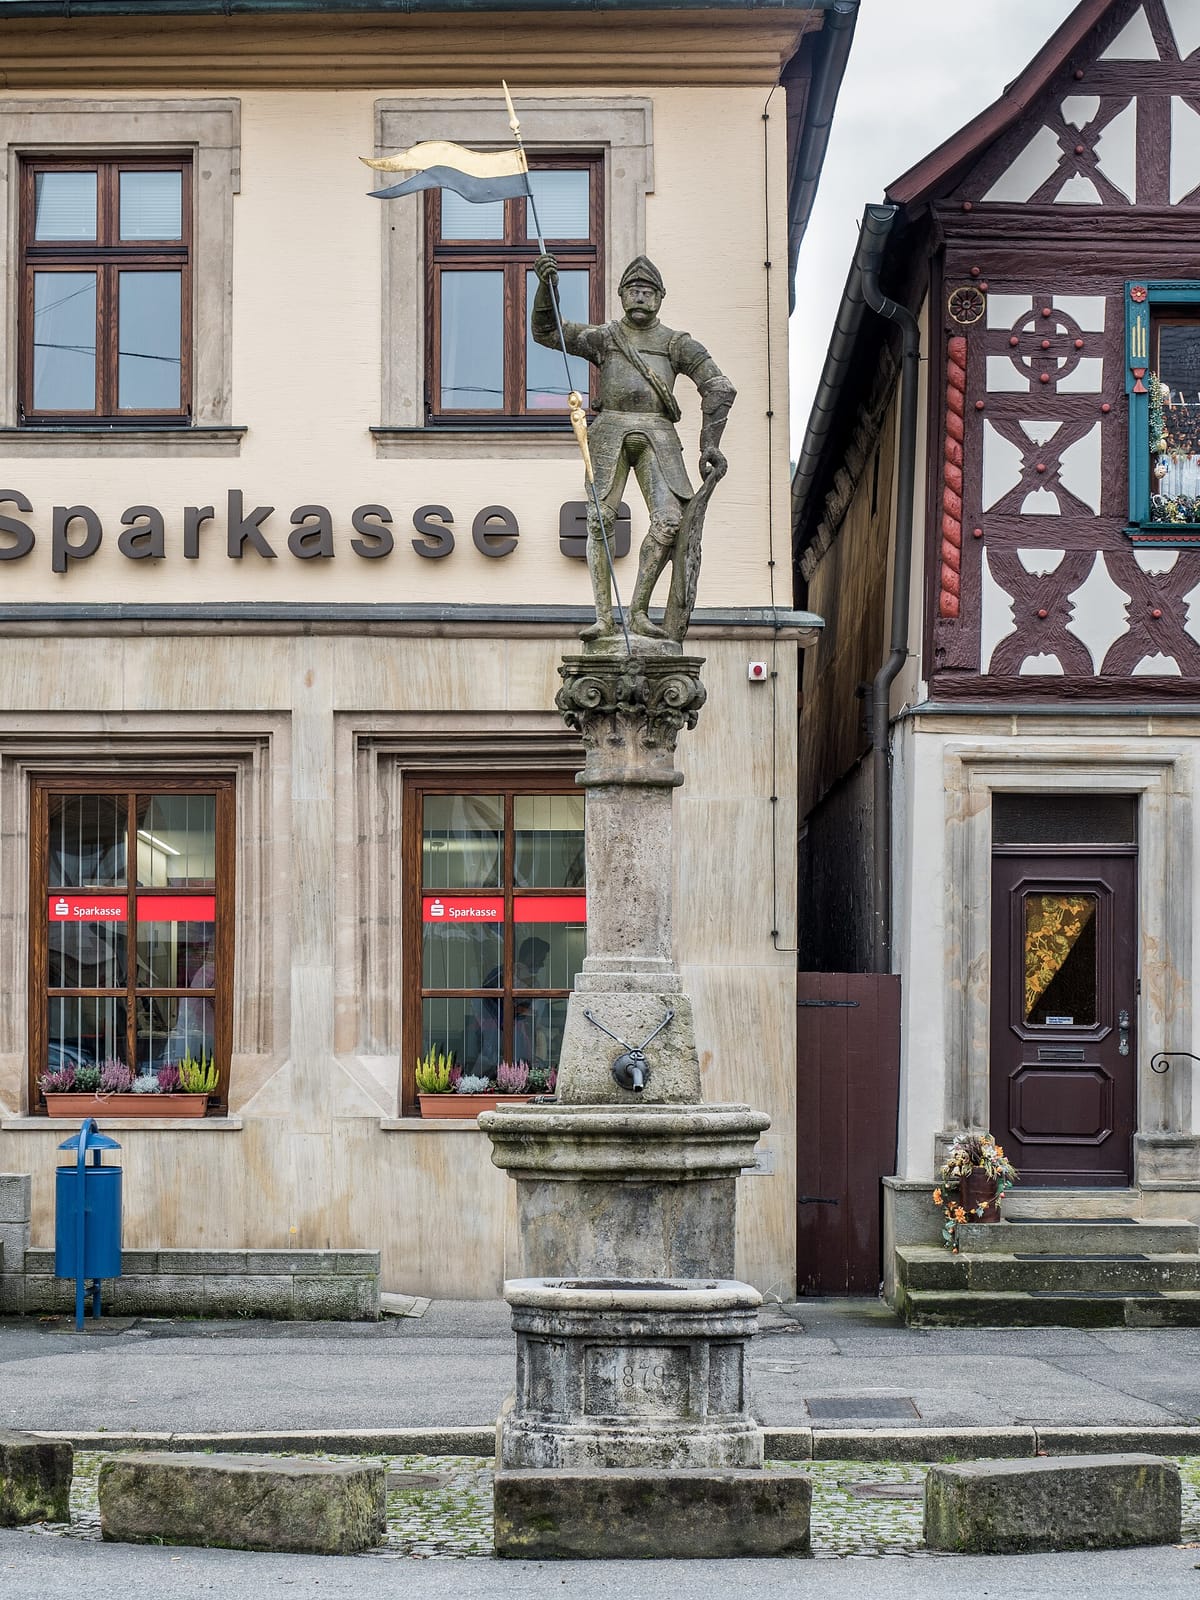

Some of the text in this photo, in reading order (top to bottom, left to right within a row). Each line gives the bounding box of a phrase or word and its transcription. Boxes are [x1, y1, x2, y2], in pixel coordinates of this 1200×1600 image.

[0, 489, 520, 573] Sparkasse
[73, 906, 121, 917] Sparkasse
[449, 907, 497, 918] Sparkasse
[610, 1365, 665, 1387] 1879
